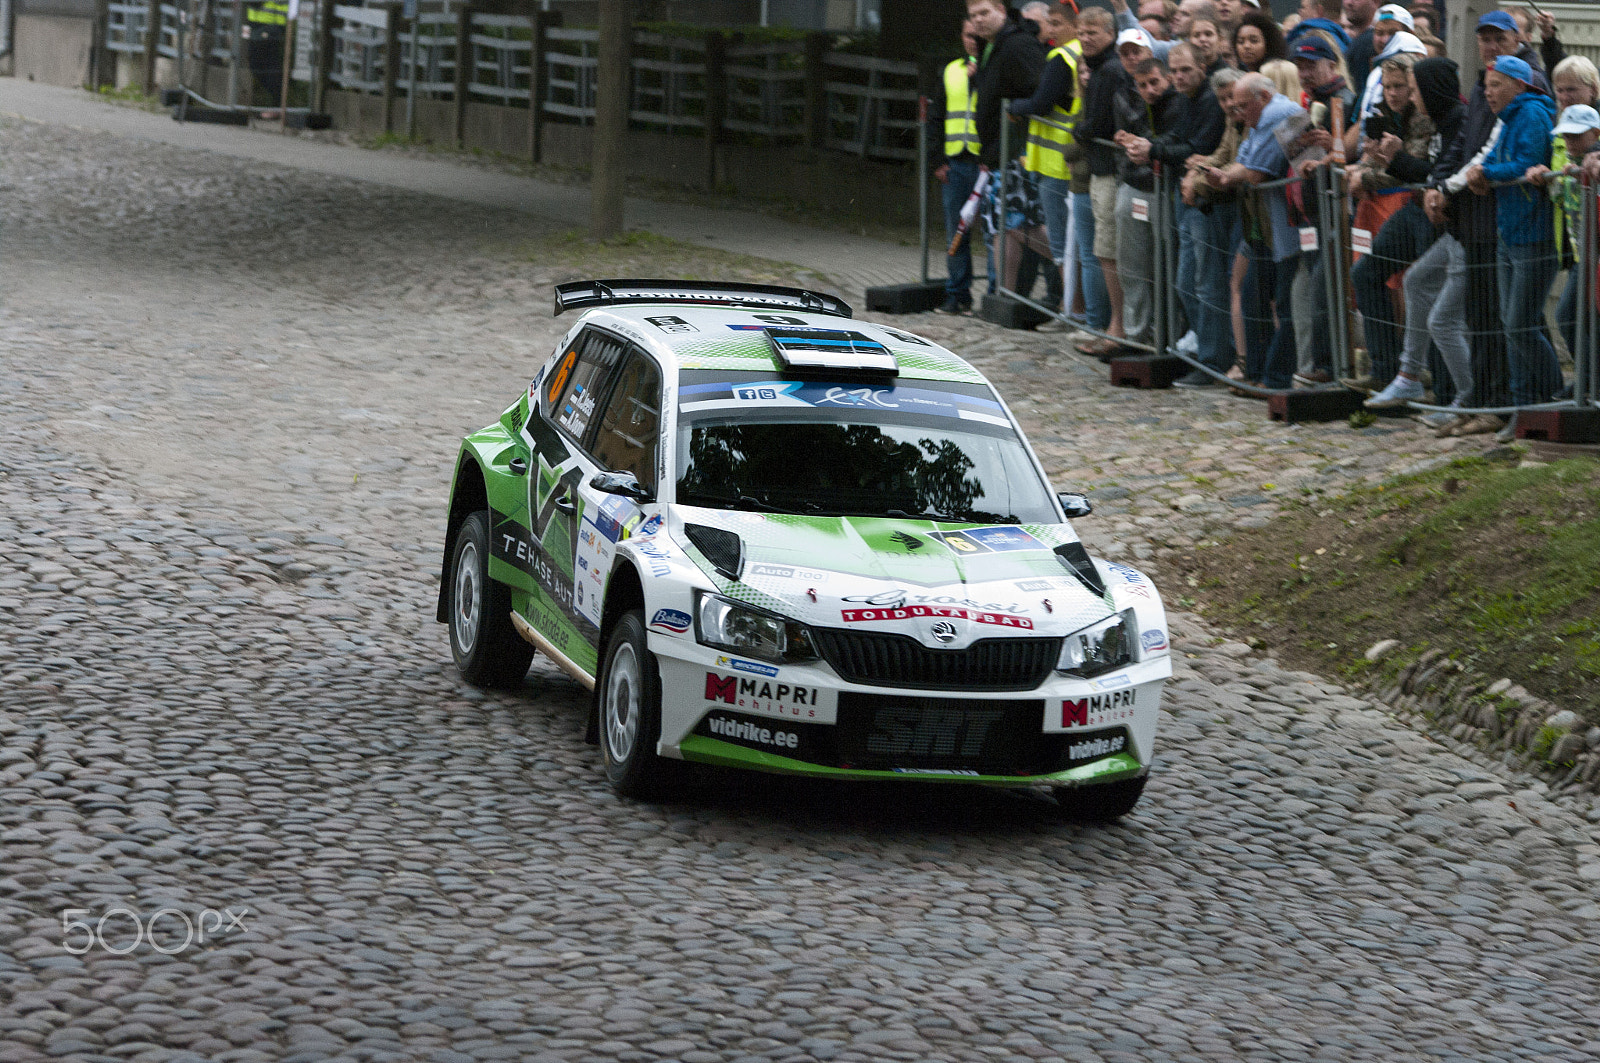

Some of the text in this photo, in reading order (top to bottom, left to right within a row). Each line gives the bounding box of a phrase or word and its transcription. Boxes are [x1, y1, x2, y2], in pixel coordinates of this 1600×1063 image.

[548, 351, 576, 402] 6
[945, 536, 978, 552] 6
[503, 533, 553, 588] TEHASE
[756, 566, 791, 577] Auto
[841, 589, 1029, 614] Grossi
[844, 605, 1033, 628] TOIDUKAUBAD
[739, 678, 818, 706] MAPRI
[1091, 688, 1136, 713] MAPRI
[738, 698, 816, 718] ehitus
[1089, 709, 1135, 725] ehitus
[708, 716, 799, 749] vidrike.ee
[1069, 736, 1126, 761] vidrike.ee
